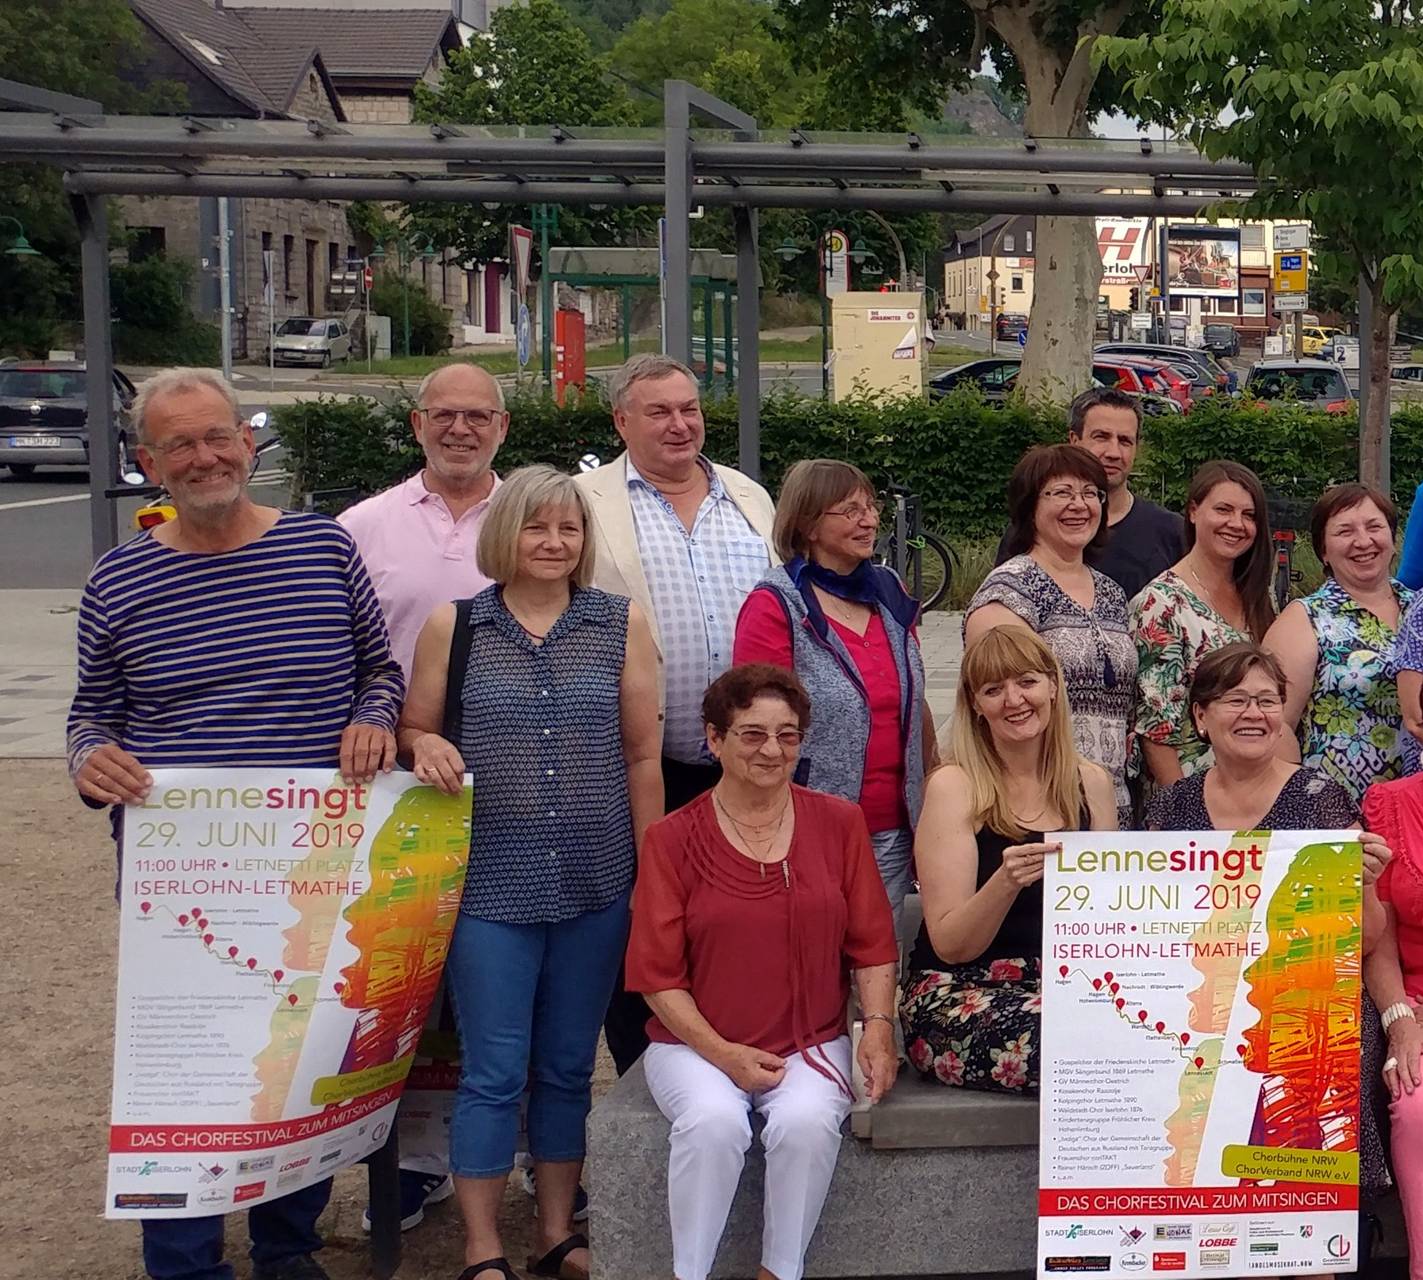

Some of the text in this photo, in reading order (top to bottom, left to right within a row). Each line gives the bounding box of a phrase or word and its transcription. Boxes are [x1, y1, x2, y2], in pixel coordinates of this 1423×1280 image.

[1103, 263, 1133, 273] erlo
[136, 822, 365, 848] 29. JUNI 2019
[135, 859, 364, 873] 11:00 UHR LETNETTI PLATZ
[1057, 841, 1263, 880] Lennesingt
[134, 879, 364, 896] ISERLOHN-LETMATHE
[1054, 884, 1261, 911] 29. JUNI 2019
[1054, 921, 1262, 936] 11:00 UHR LETNETTI PLATZ
[1053, 942, 1262, 960] ISERLOHN-LETMATHE
[130, 1132, 167, 1147] DAS
[171, 1127, 294, 1147] CHORFESTIVAL
[297, 1117, 329, 1136] ZUM
[330, 1090, 393, 1127] MITSINGEN
[1252, 1152, 1338, 1166] Chorbühne NRW
[1235, 1164, 1303, 1178] ChorVerband
[1305, 1168, 1331, 1179] NRW
[1057, 1191, 1338, 1211] DAS CHORFESTIVAL ZUM MITSINGEN
[1045, 1229, 1068, 1237] STADT
[1199, 1238, 1238, 1248] LOBBE
